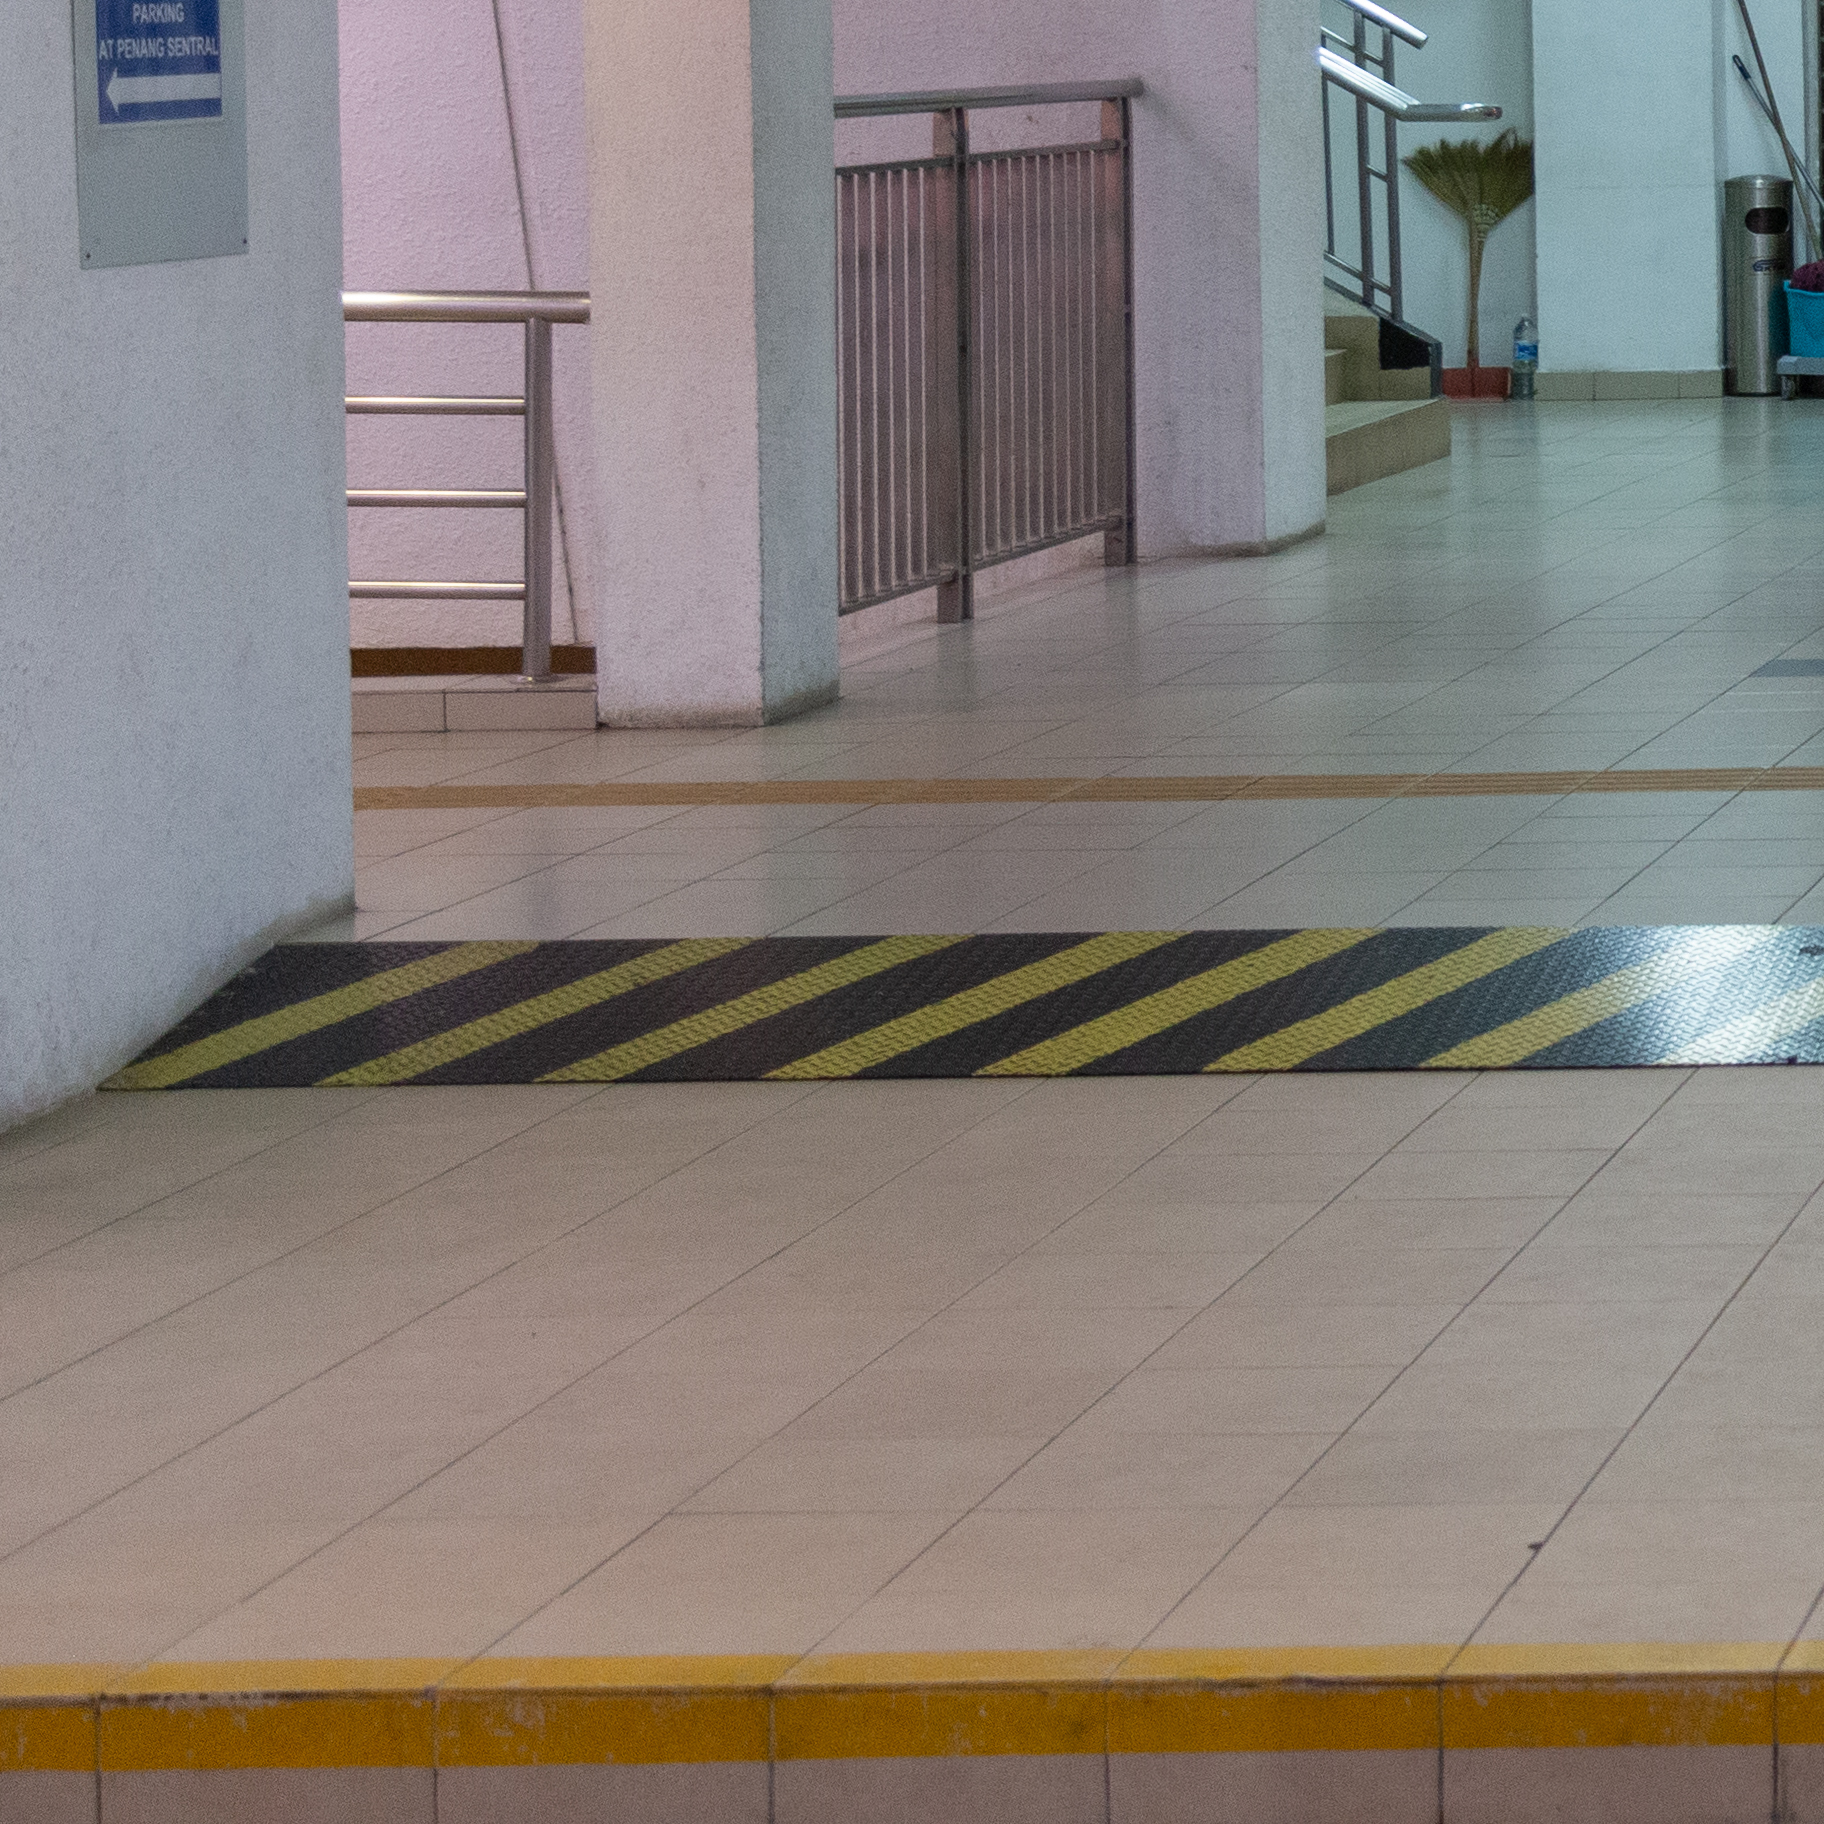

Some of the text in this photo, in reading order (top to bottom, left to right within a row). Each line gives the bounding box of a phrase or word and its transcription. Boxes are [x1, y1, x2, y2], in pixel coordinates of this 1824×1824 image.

[132, 2, 185, 24] PARKING
[100, 36, 219, 60] AT PENANG SENTRAL
